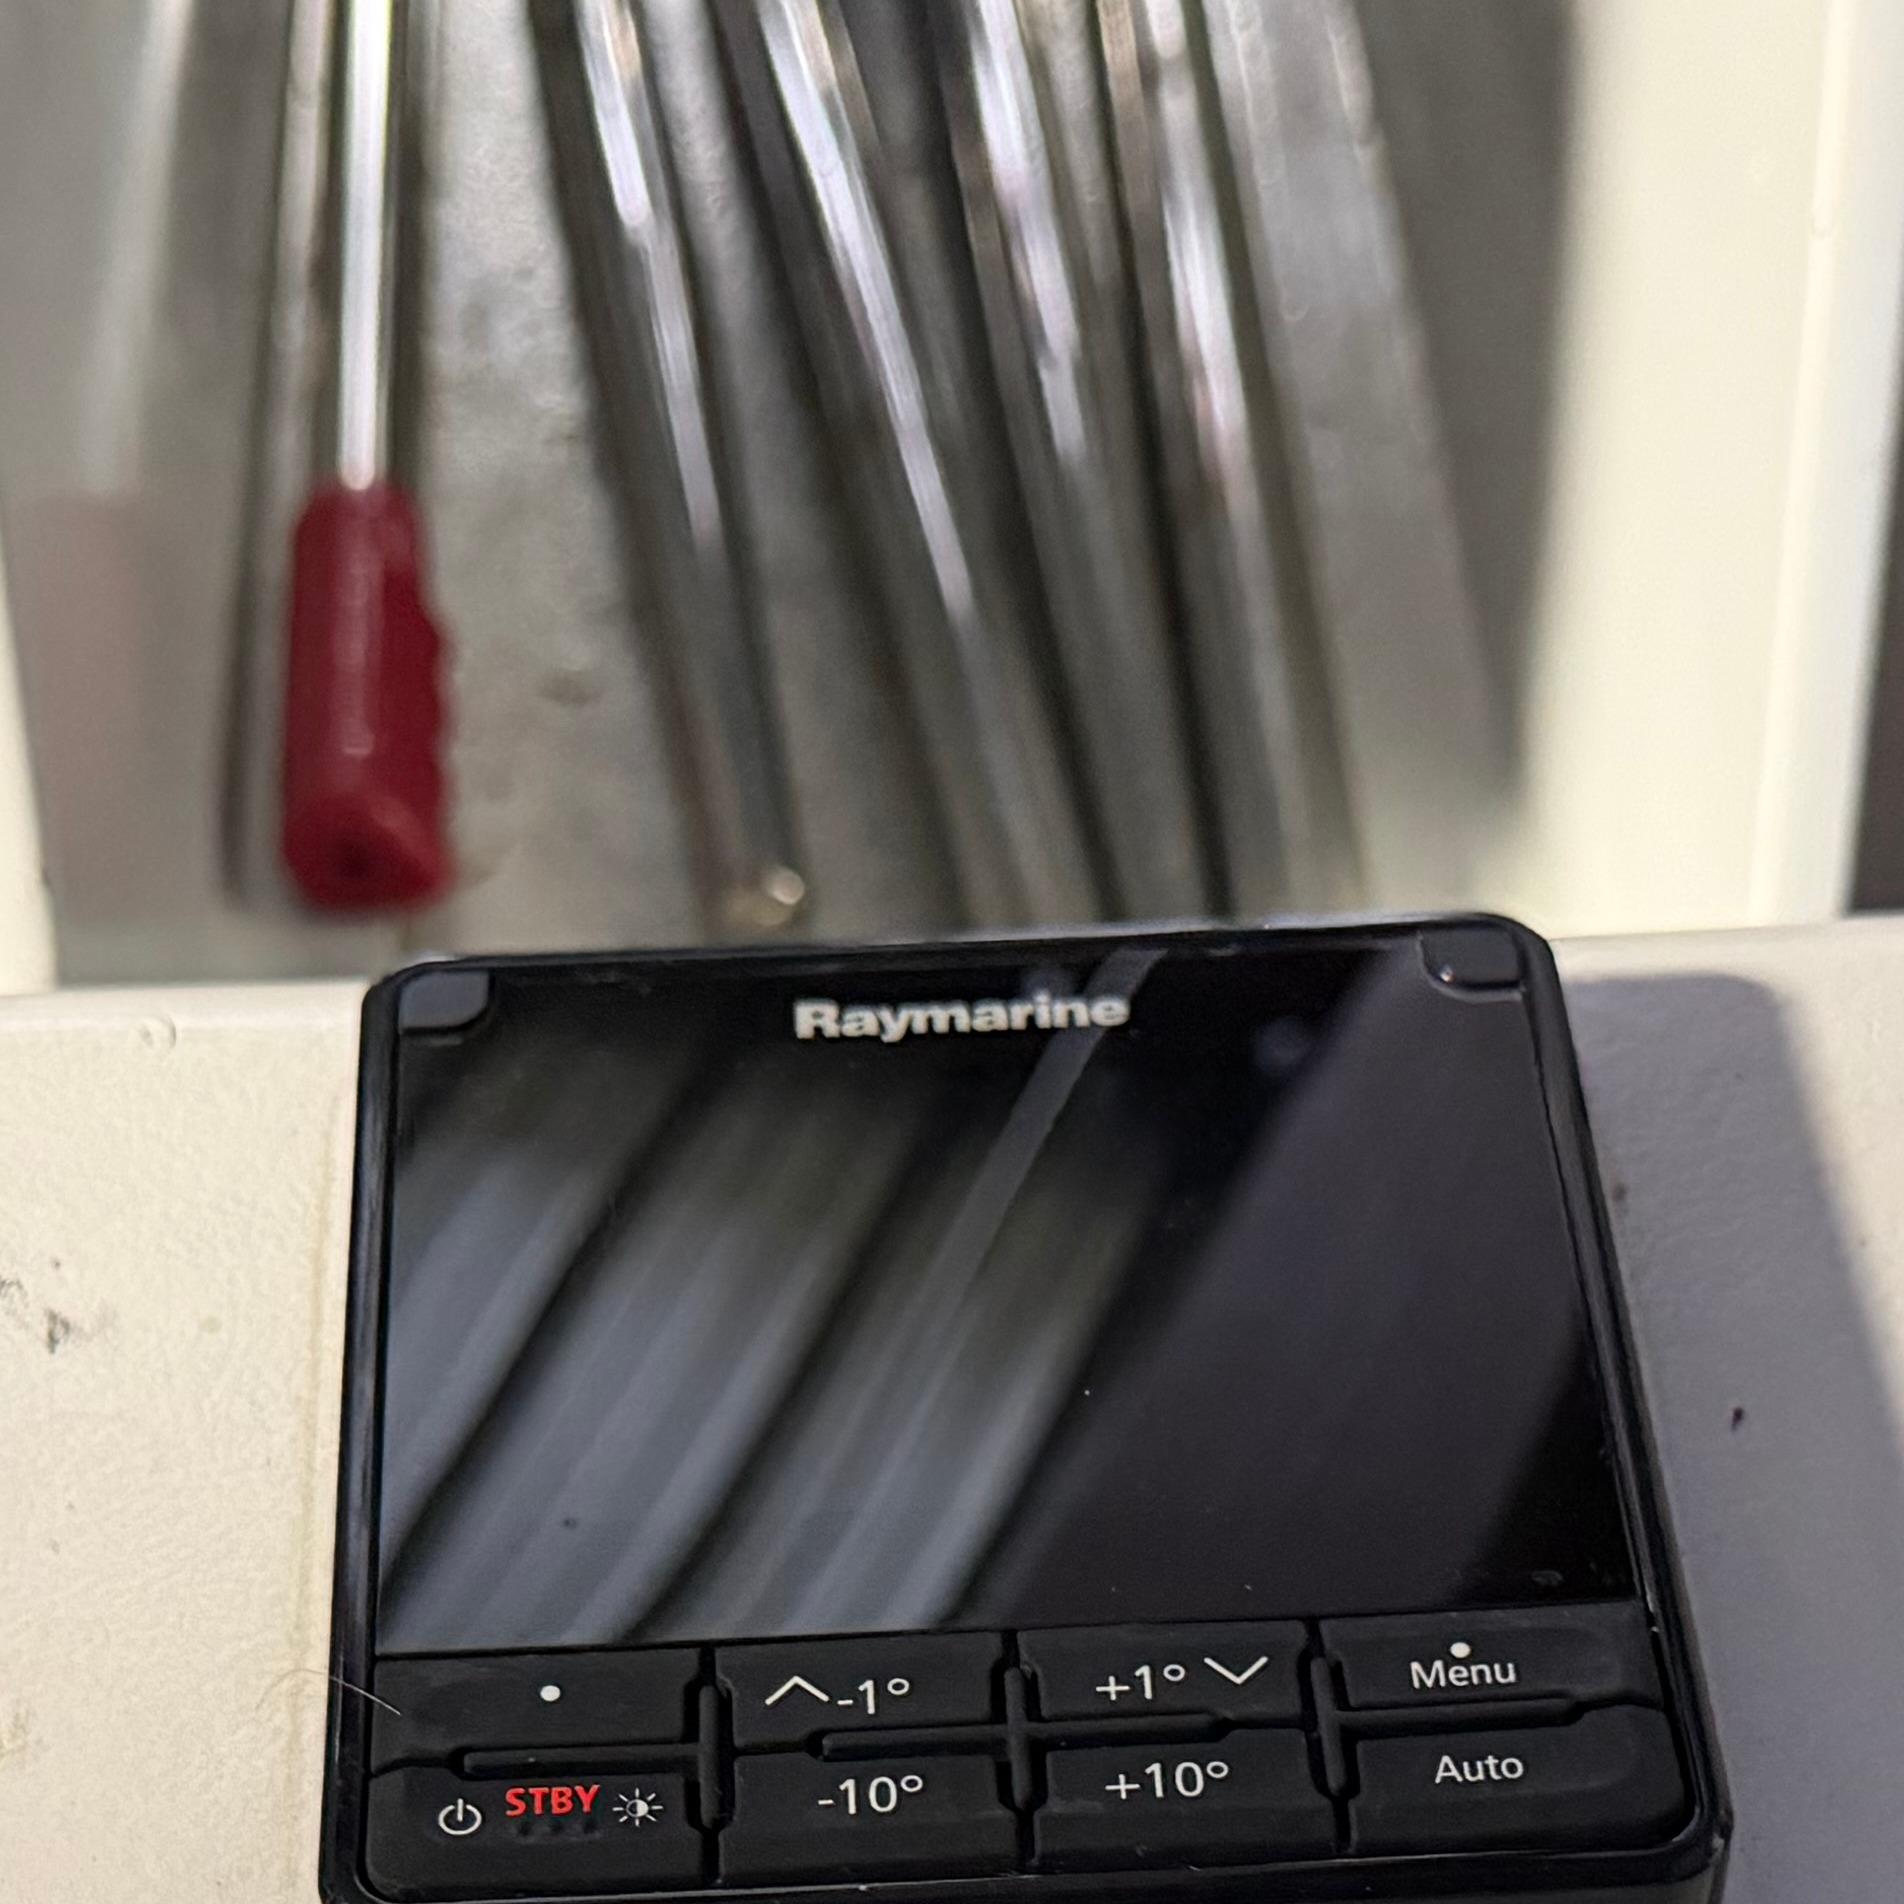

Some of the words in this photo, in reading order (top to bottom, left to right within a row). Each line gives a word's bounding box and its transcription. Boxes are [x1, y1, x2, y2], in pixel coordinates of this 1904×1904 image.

[793, 988, 1130, 1043] Raymarine
[1411, 1660, 1516, 1690] Menu
[1434, 1755, 1525, 1785] Auto
[505, 1784, 601, 1817] STBY
